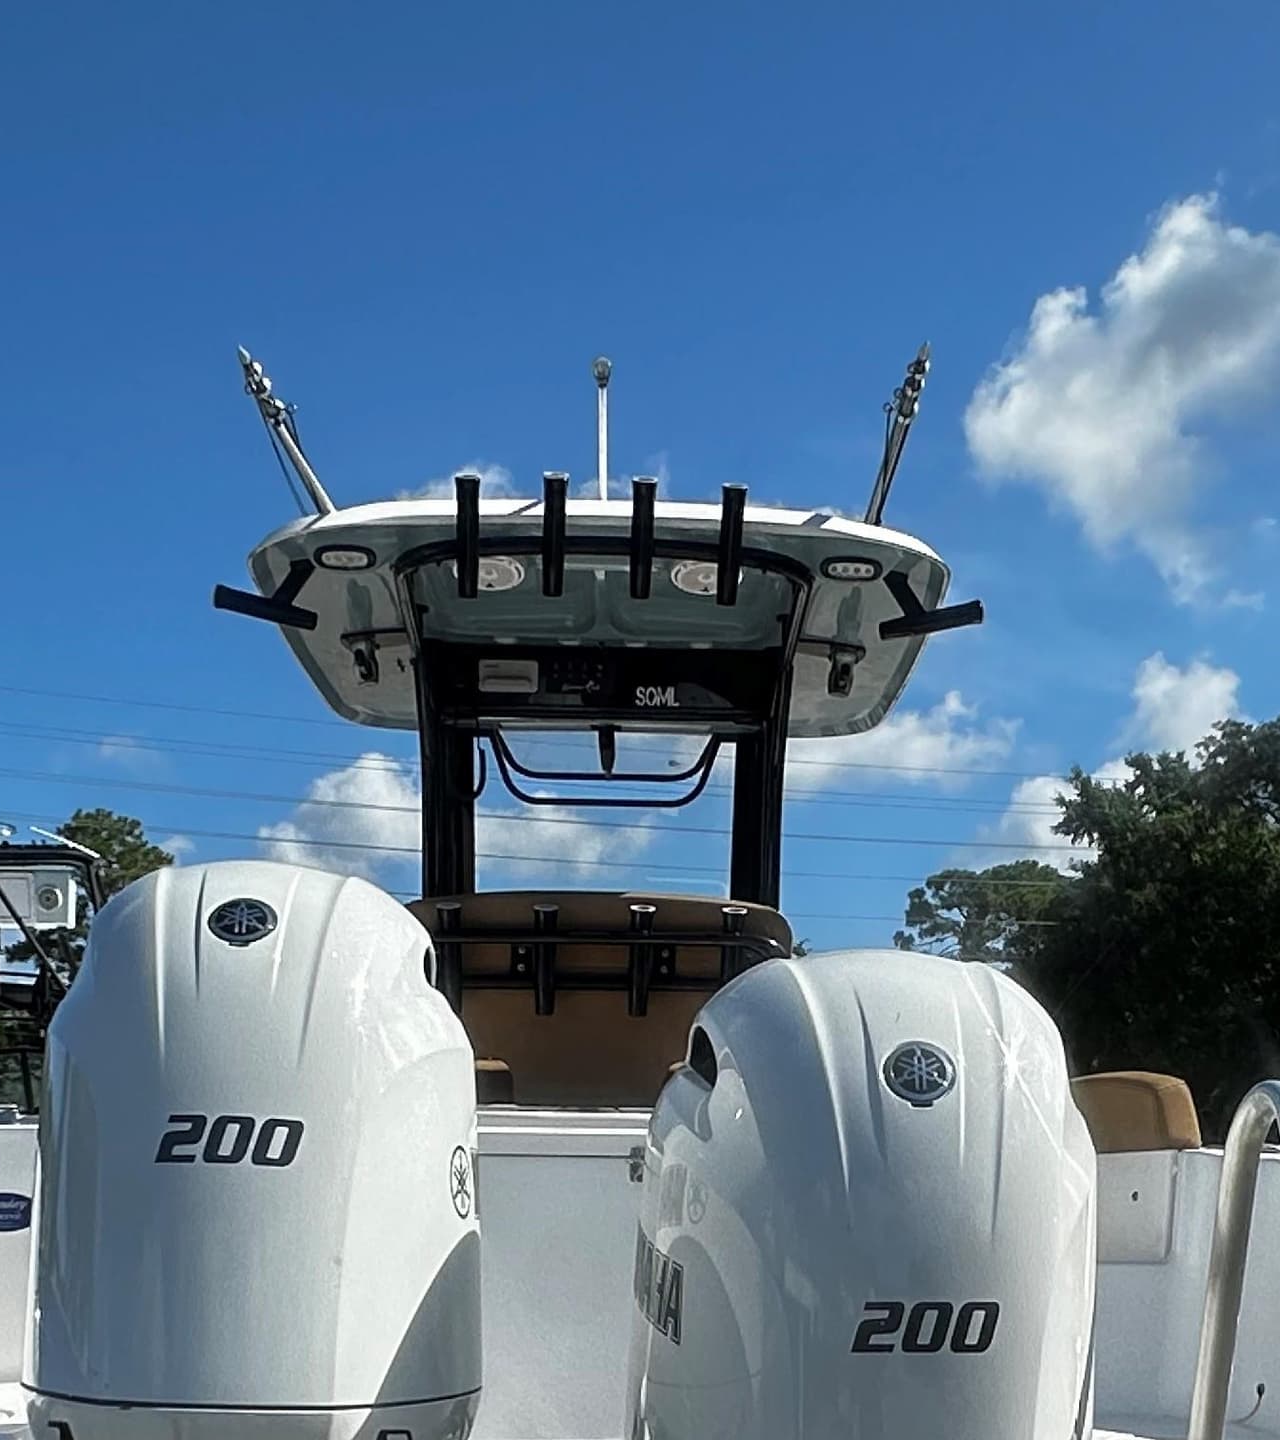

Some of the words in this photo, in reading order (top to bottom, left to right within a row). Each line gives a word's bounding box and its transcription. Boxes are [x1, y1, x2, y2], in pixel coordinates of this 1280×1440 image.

[635, 686, 680, 708] SOML
[154, 1113, 305, 1167] 200
[850, 1300, 1001, 1354] 200
